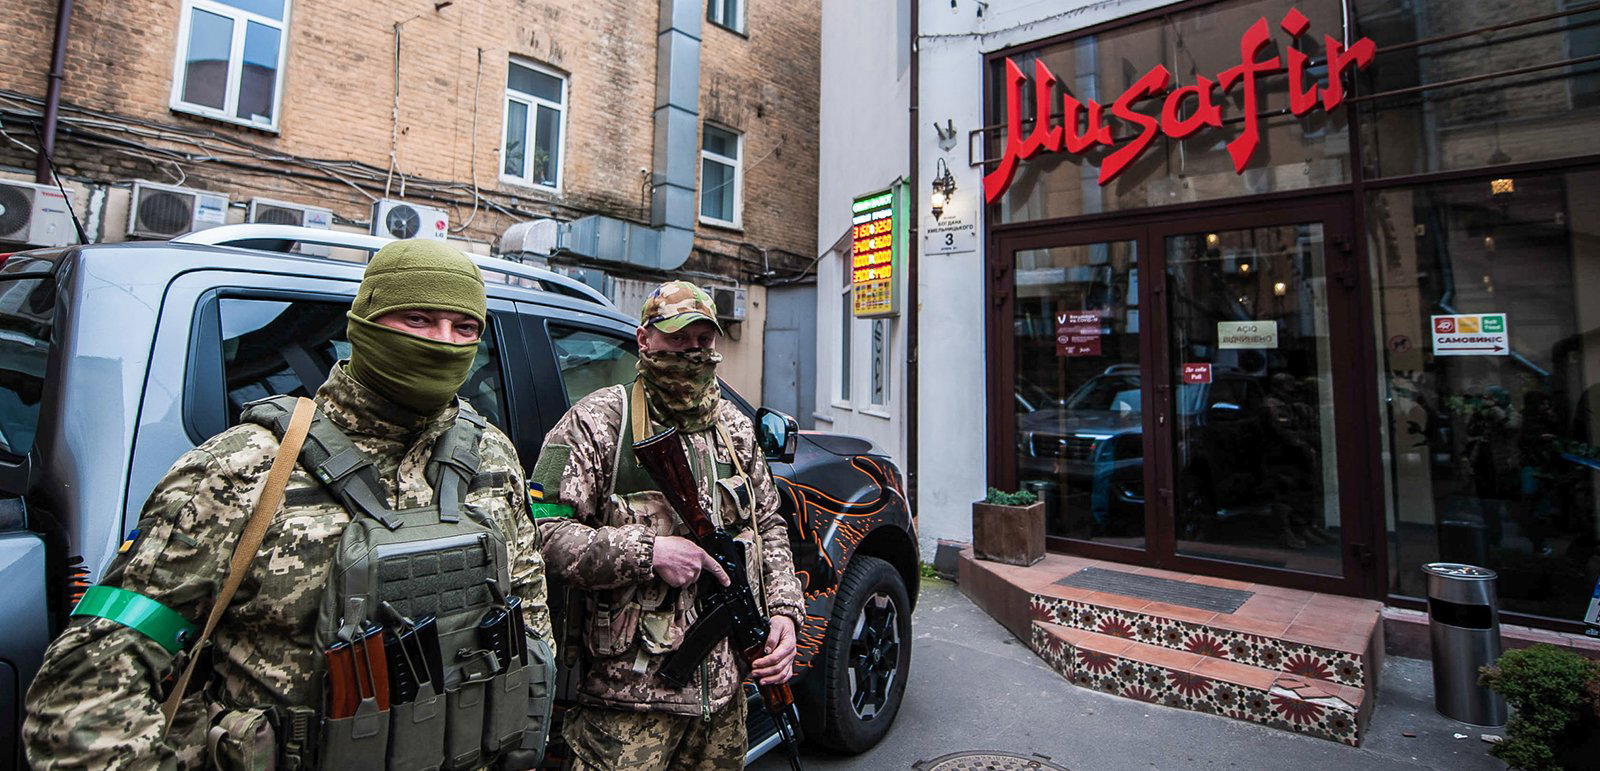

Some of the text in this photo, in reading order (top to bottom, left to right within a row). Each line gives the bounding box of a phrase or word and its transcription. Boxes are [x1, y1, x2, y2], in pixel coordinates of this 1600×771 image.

[982, 7, 1376, 204] Musafir
[945, 233, 954, 246] 3
[1437, 336, 1503, 344] САМОВИНІС
